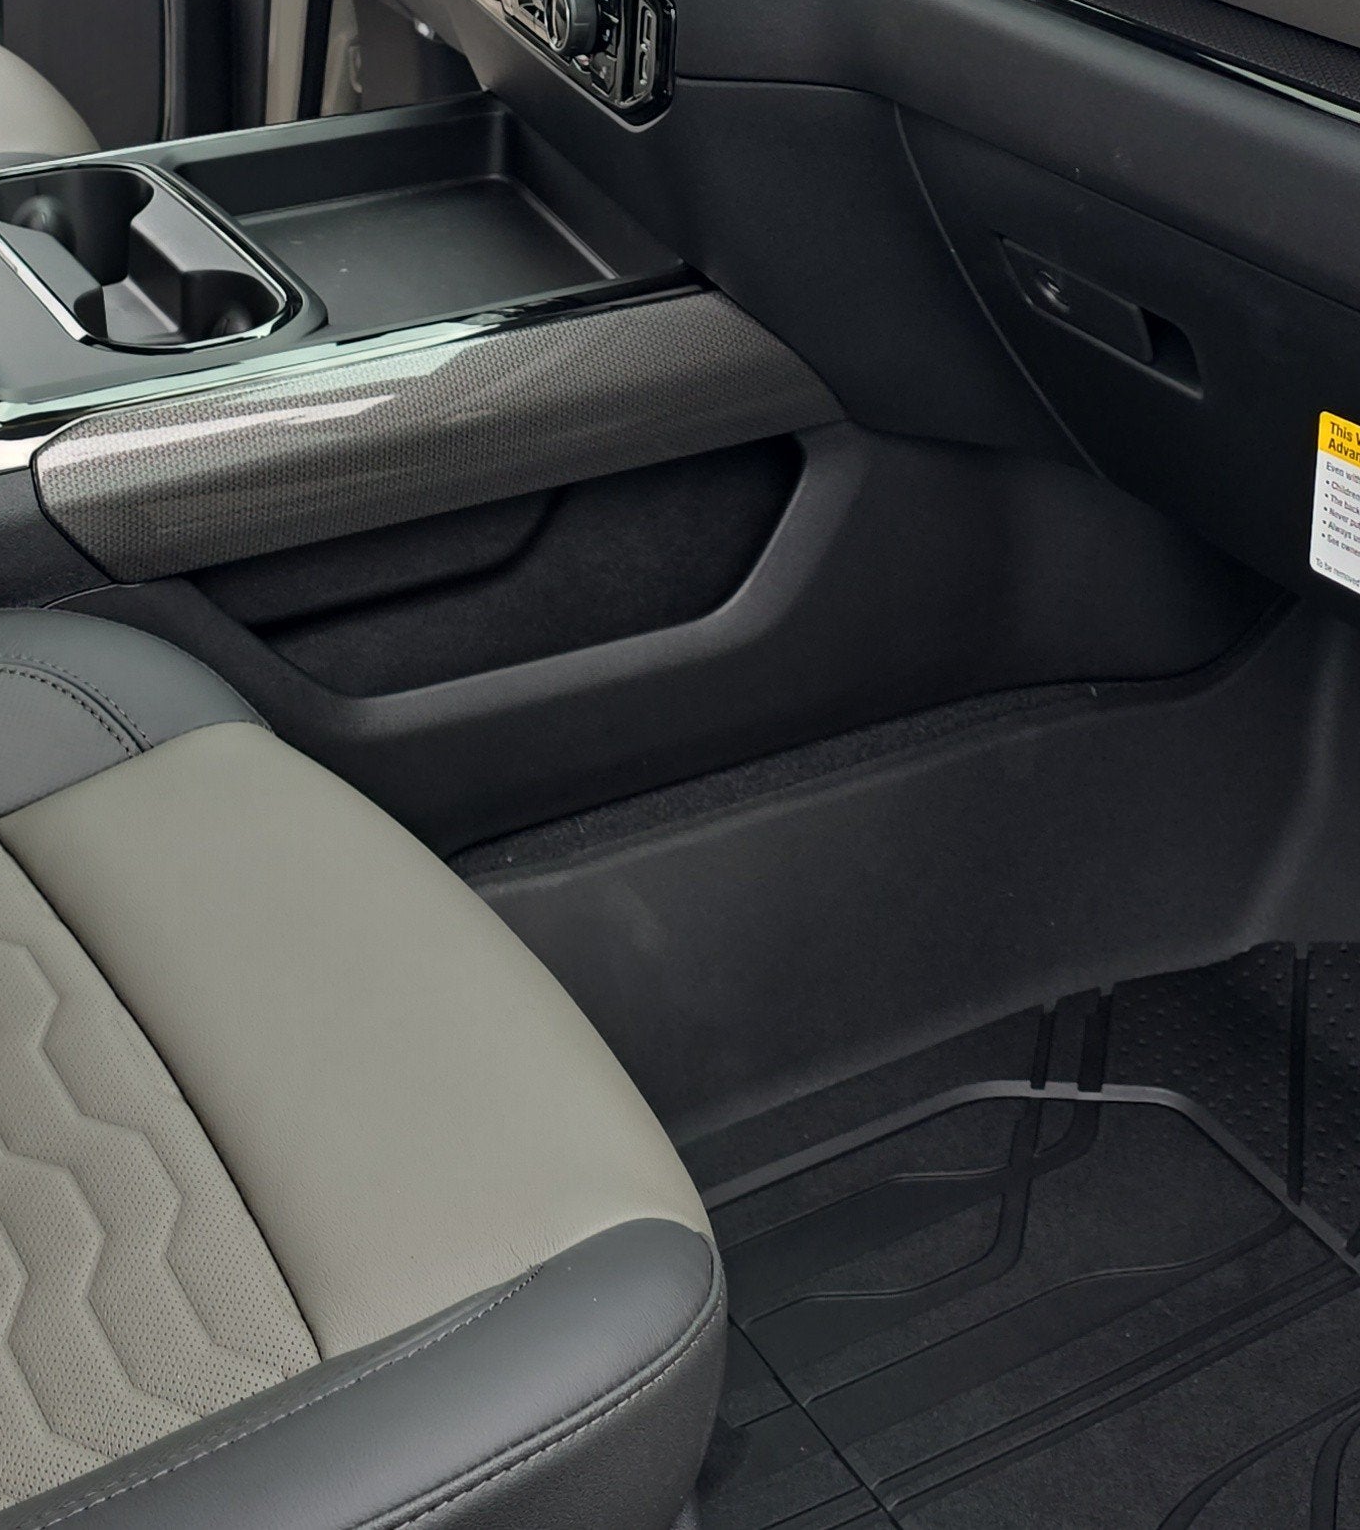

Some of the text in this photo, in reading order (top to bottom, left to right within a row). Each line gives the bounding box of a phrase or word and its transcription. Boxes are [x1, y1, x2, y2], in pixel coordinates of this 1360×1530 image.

[1329, 420, 1353, 442] This
[1326, 460, 1344, 478] Even
[1345, 469, 1360, 486] with
[1331, 479, 1360, 502] Children
